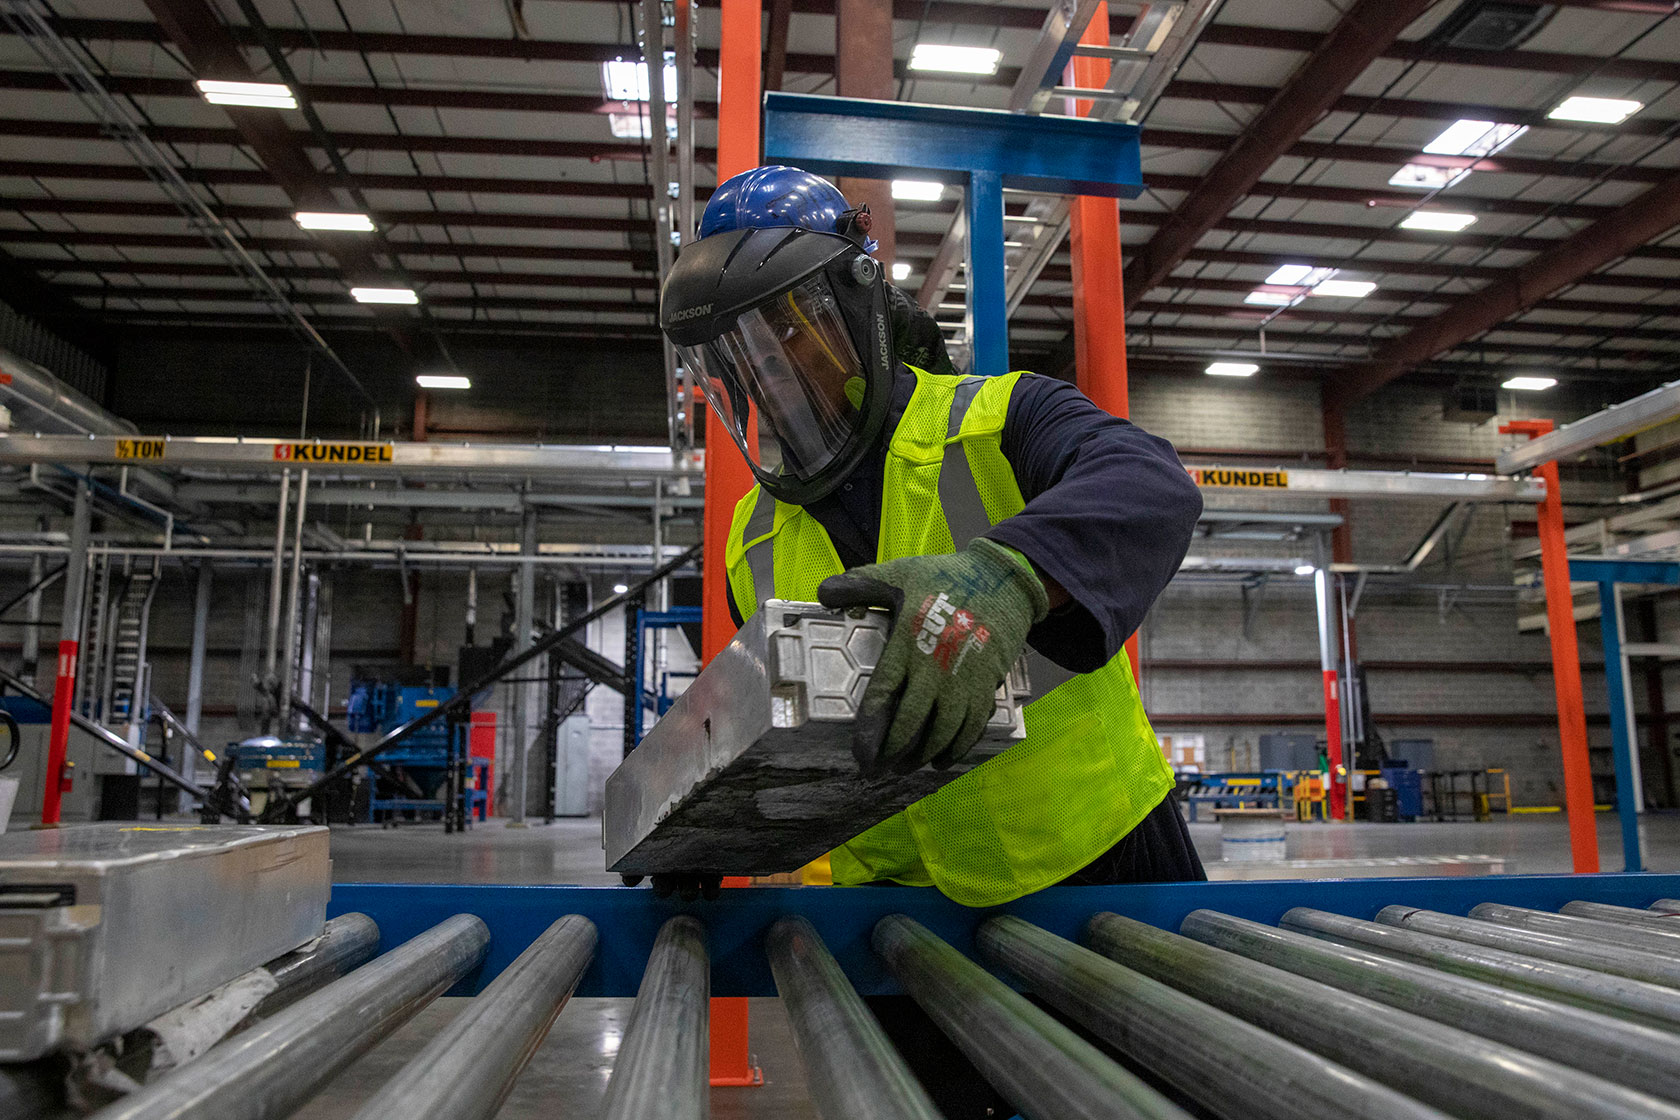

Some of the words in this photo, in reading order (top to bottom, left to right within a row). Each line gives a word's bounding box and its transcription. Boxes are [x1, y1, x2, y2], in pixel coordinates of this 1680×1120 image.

[669, 304, 712, 323] JACKSON
[876, 312, 890, 370] JACKSON
[132, 441, 164, 457] TON
[294, 444, 392, 462] KUNDEL
[1202, 470, 1288, 487] KUNDEL
[916, 592, 957, 655] CUT
